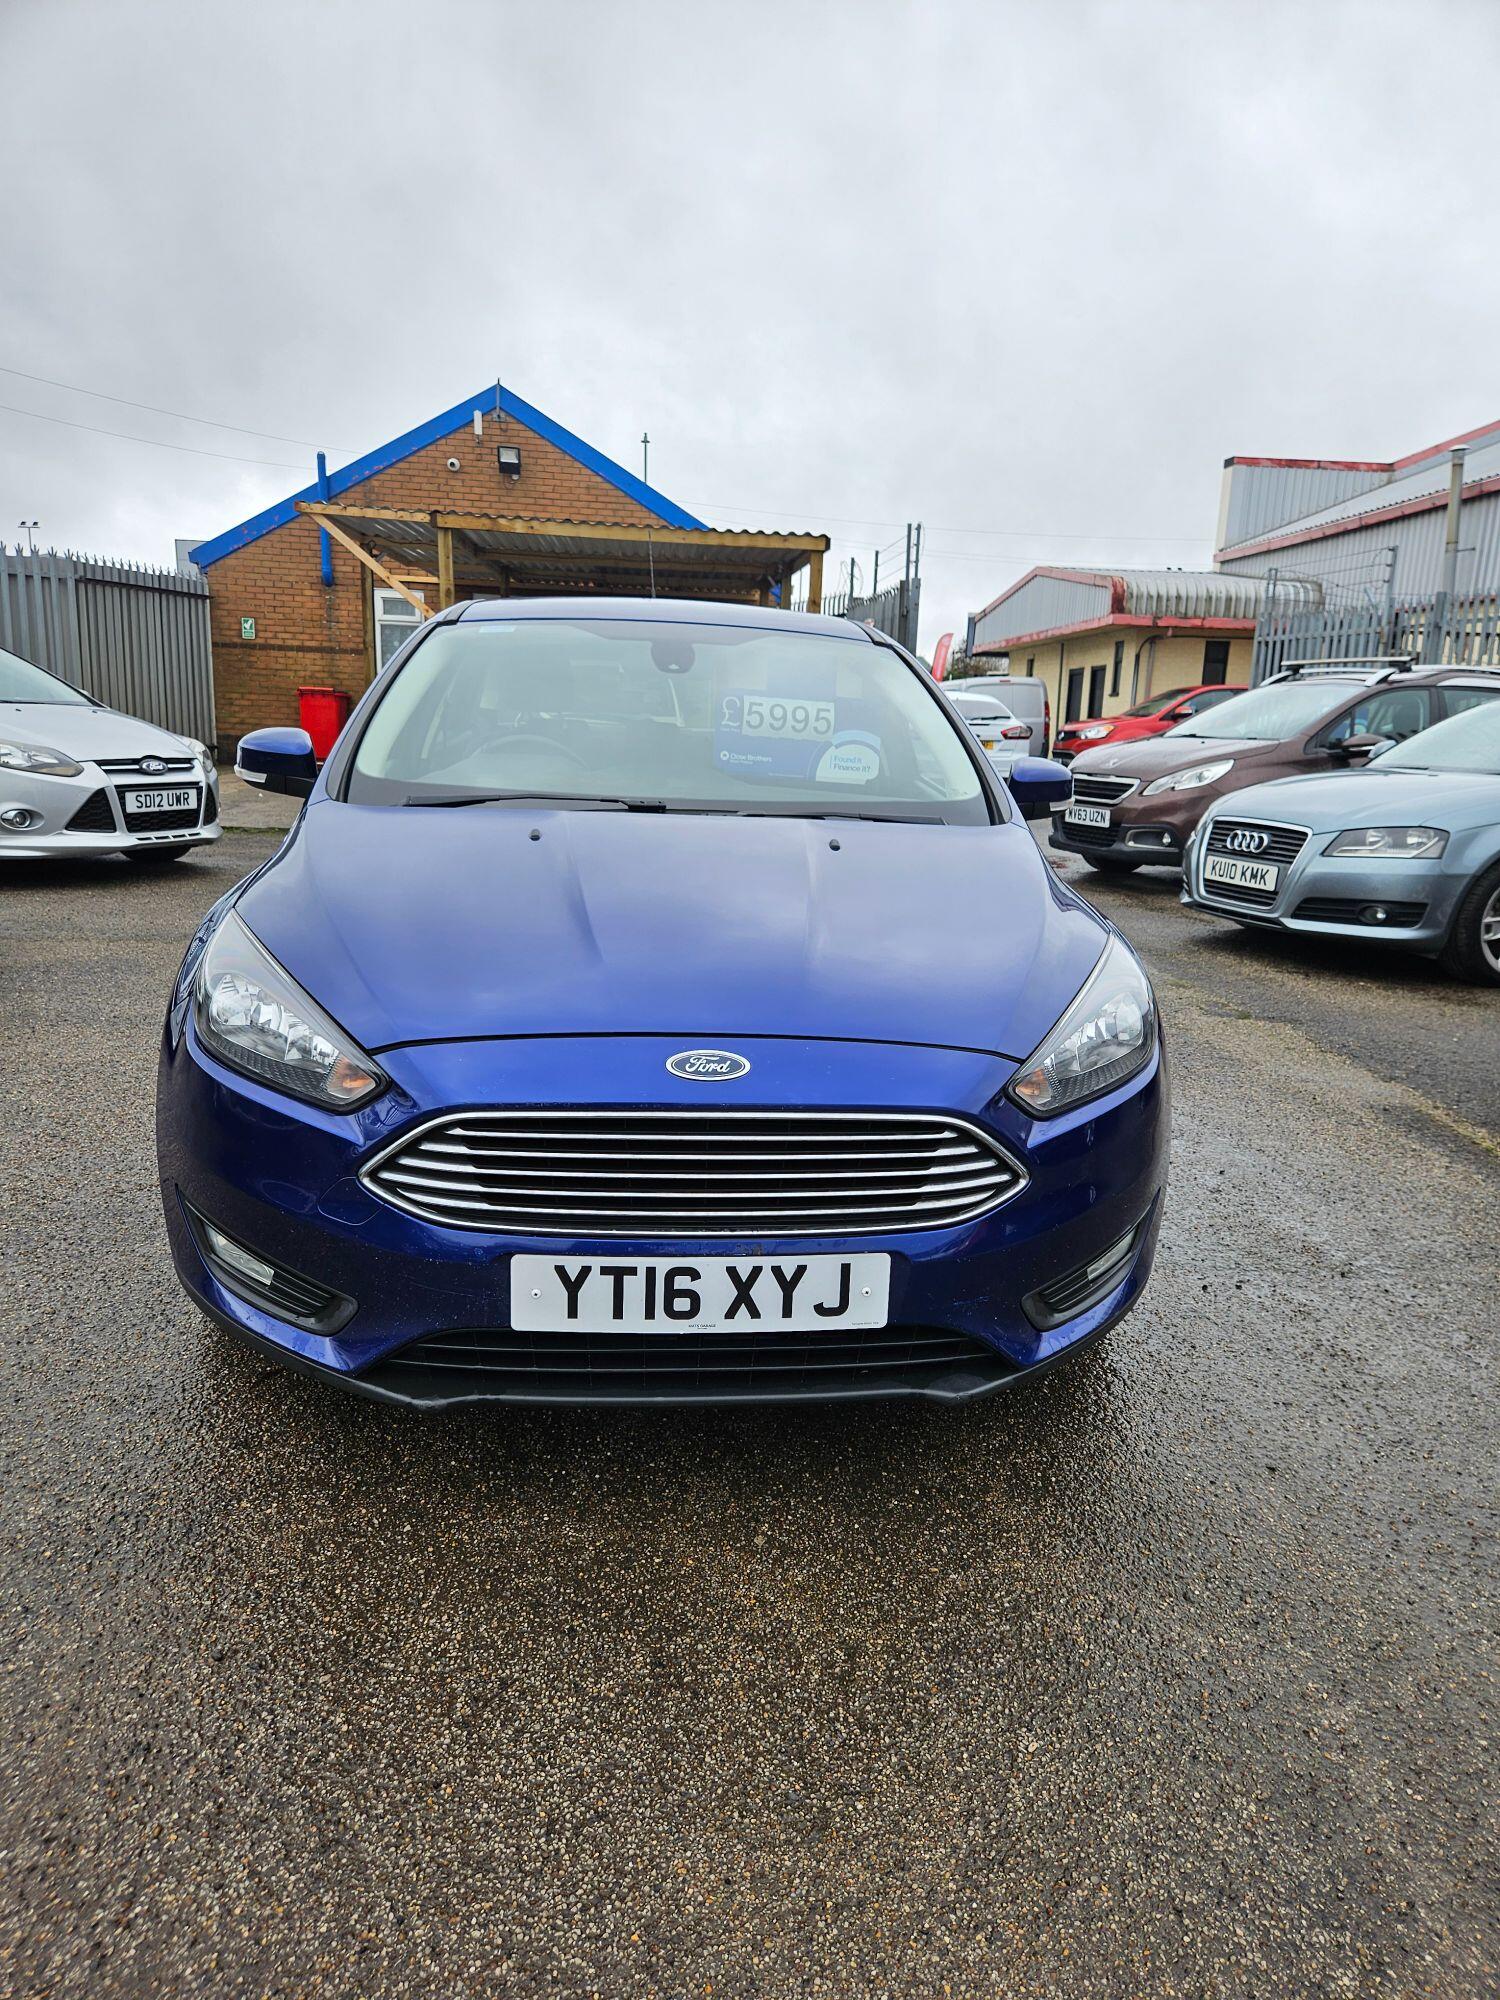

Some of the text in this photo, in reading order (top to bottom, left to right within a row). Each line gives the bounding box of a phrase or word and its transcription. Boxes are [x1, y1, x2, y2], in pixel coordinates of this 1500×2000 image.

[833, 763, 860, 772] Finance
[135, 791, 190, 809] SD12 UWR
[1090, 809, 1106, 824] UZN
[1211, 860, 1269, 886] KU10 KMK
[685, 1055, 731, 1073] Ford
[554, 1263, 851, 1320] YT16 XYJ
